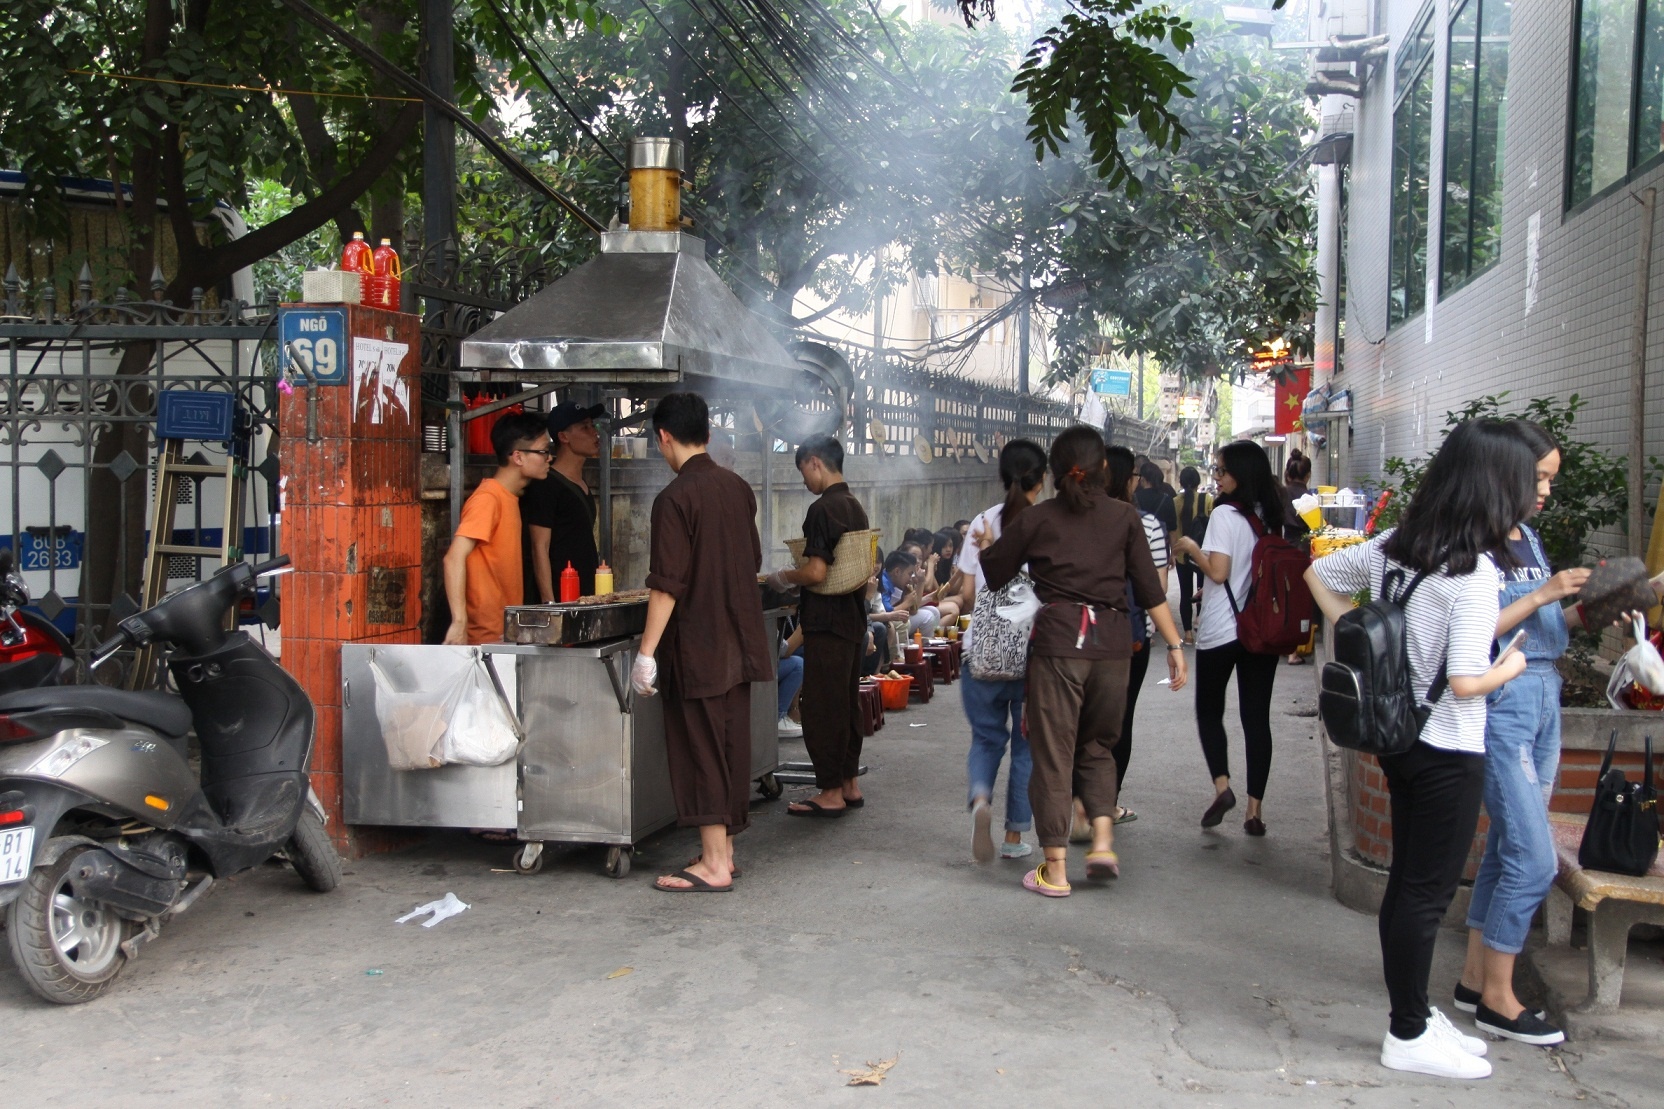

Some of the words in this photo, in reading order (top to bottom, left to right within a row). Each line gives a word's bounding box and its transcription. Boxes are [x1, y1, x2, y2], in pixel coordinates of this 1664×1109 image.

[300, 315, 327, 332] NGÕ
[291, 337, 337, 375] 69
[6, 856, 23, 879] 14
